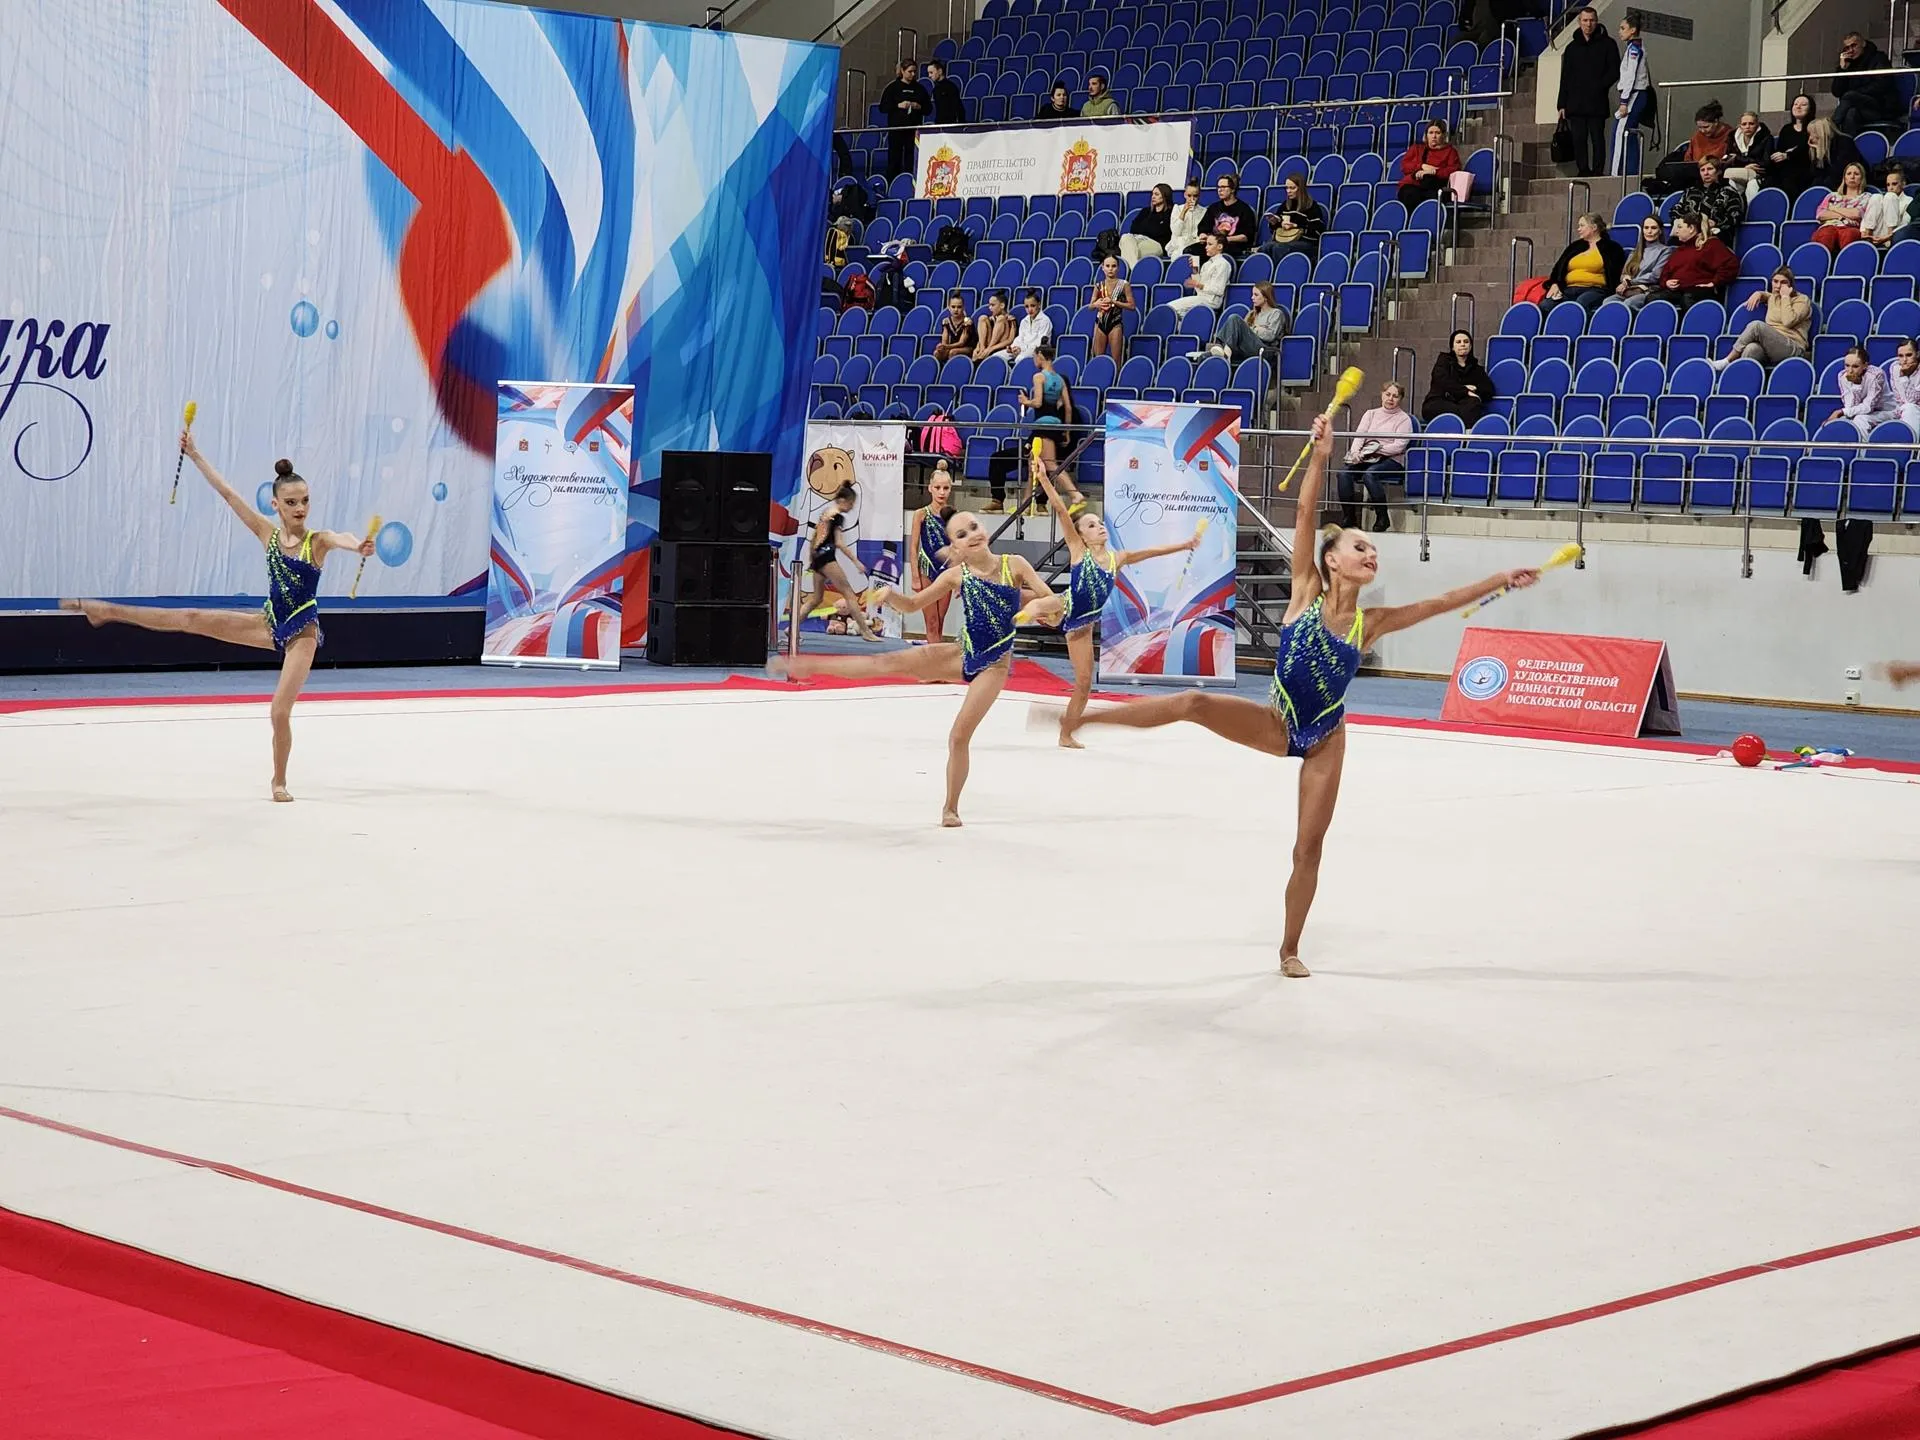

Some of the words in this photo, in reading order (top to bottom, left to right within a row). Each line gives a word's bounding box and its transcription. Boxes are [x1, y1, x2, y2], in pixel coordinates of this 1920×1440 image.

[966, 157, 1036, 170] ПРАВИТЕЛЬСТВО
[1104, 152, 1179, 164] ПРАВИТЕЛЬСТВО
[964, 169, 1024, 182] МОСКОВСКОЙ
[1103, 164, 1166, 178] МОСКОВСКОЙ
[553, 482, 618, 506] гимнастика
[1164, 503, 1229, 525] гимнастика
[1517, 659, 1584, 673] ФЕДЕРАЦИЯ
[1513, 670, 1619, 687] ХУДОЖЕСТВЕННОЙ
[1510, 682, 1585, 697] ГИМНАСТИКИ
[1506, 694, 1582, 709] МОСКОВСКОЙ
[1584, 700, 1637, 714] ОБЛАСТИ
